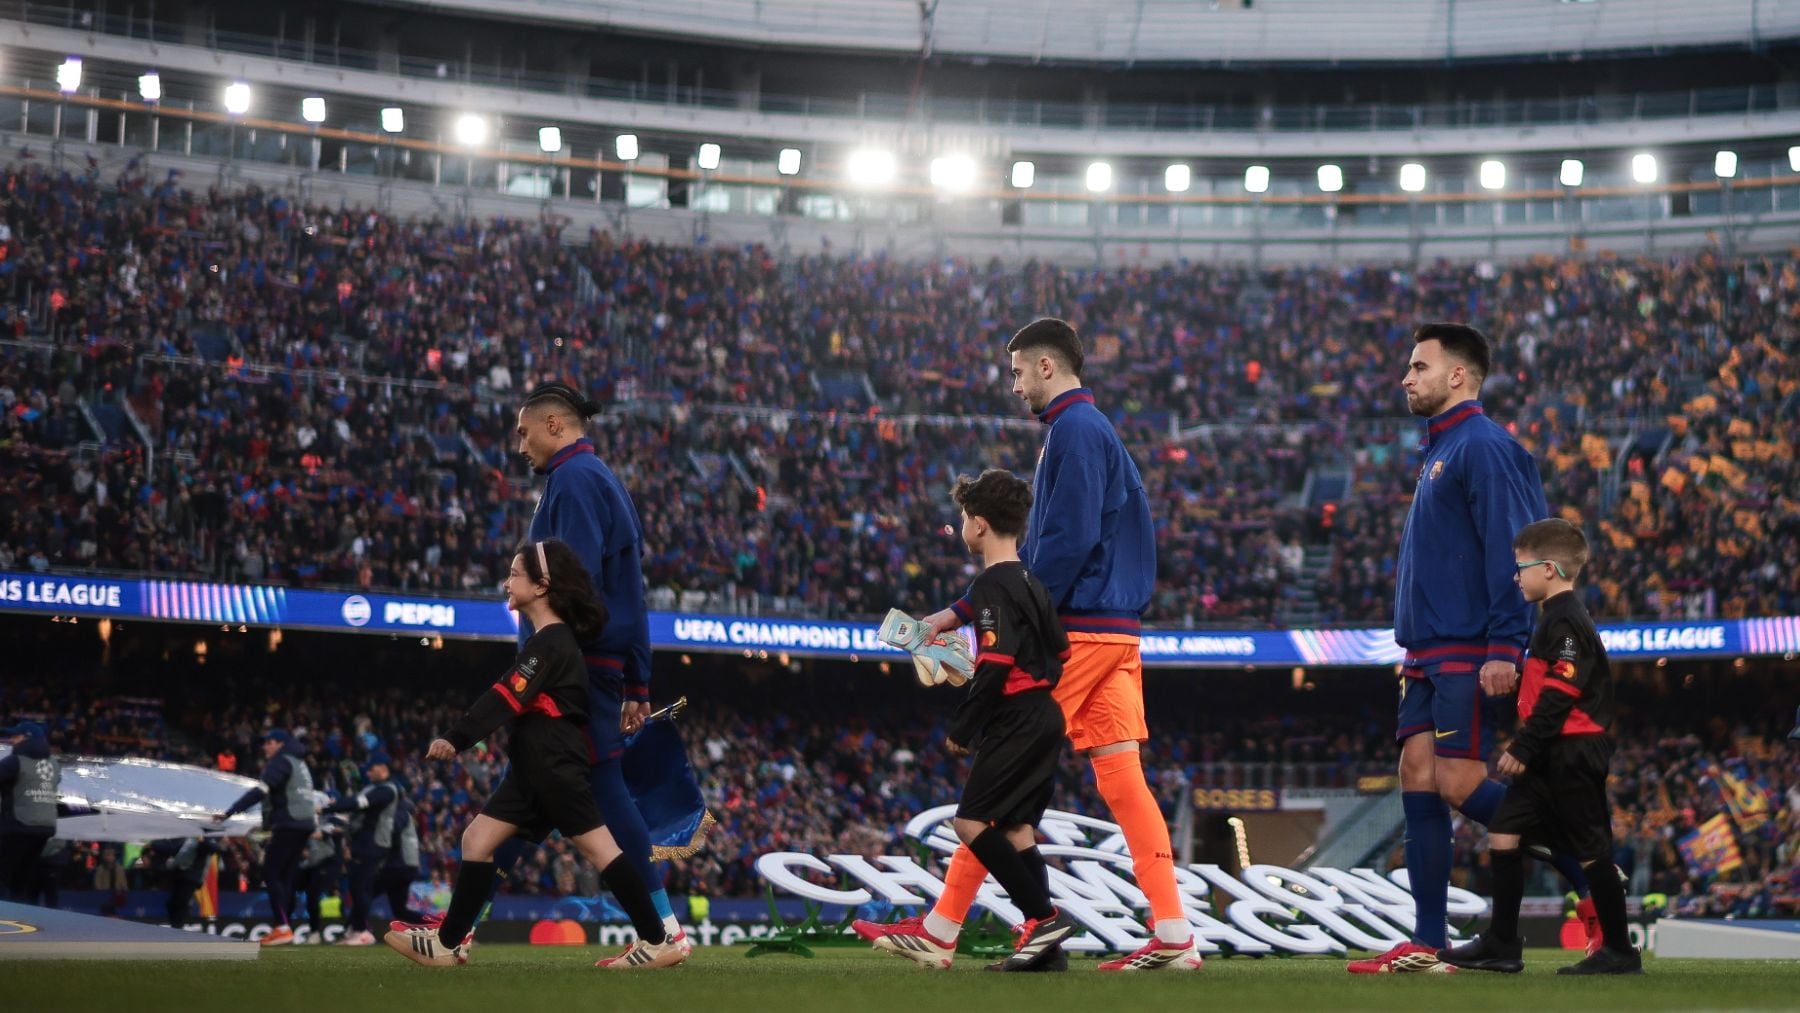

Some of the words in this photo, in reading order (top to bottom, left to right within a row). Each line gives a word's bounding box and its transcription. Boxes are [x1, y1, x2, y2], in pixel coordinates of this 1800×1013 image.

[26, 580, 121, 607] LEAGUE
[384, 601, 455, 627] PEPSI
[674, 619, 728, 643] UEFA
[729, 621, 850, 650] CHAMPIONS
[1643, 626, 1725, 650] LEAGUE
